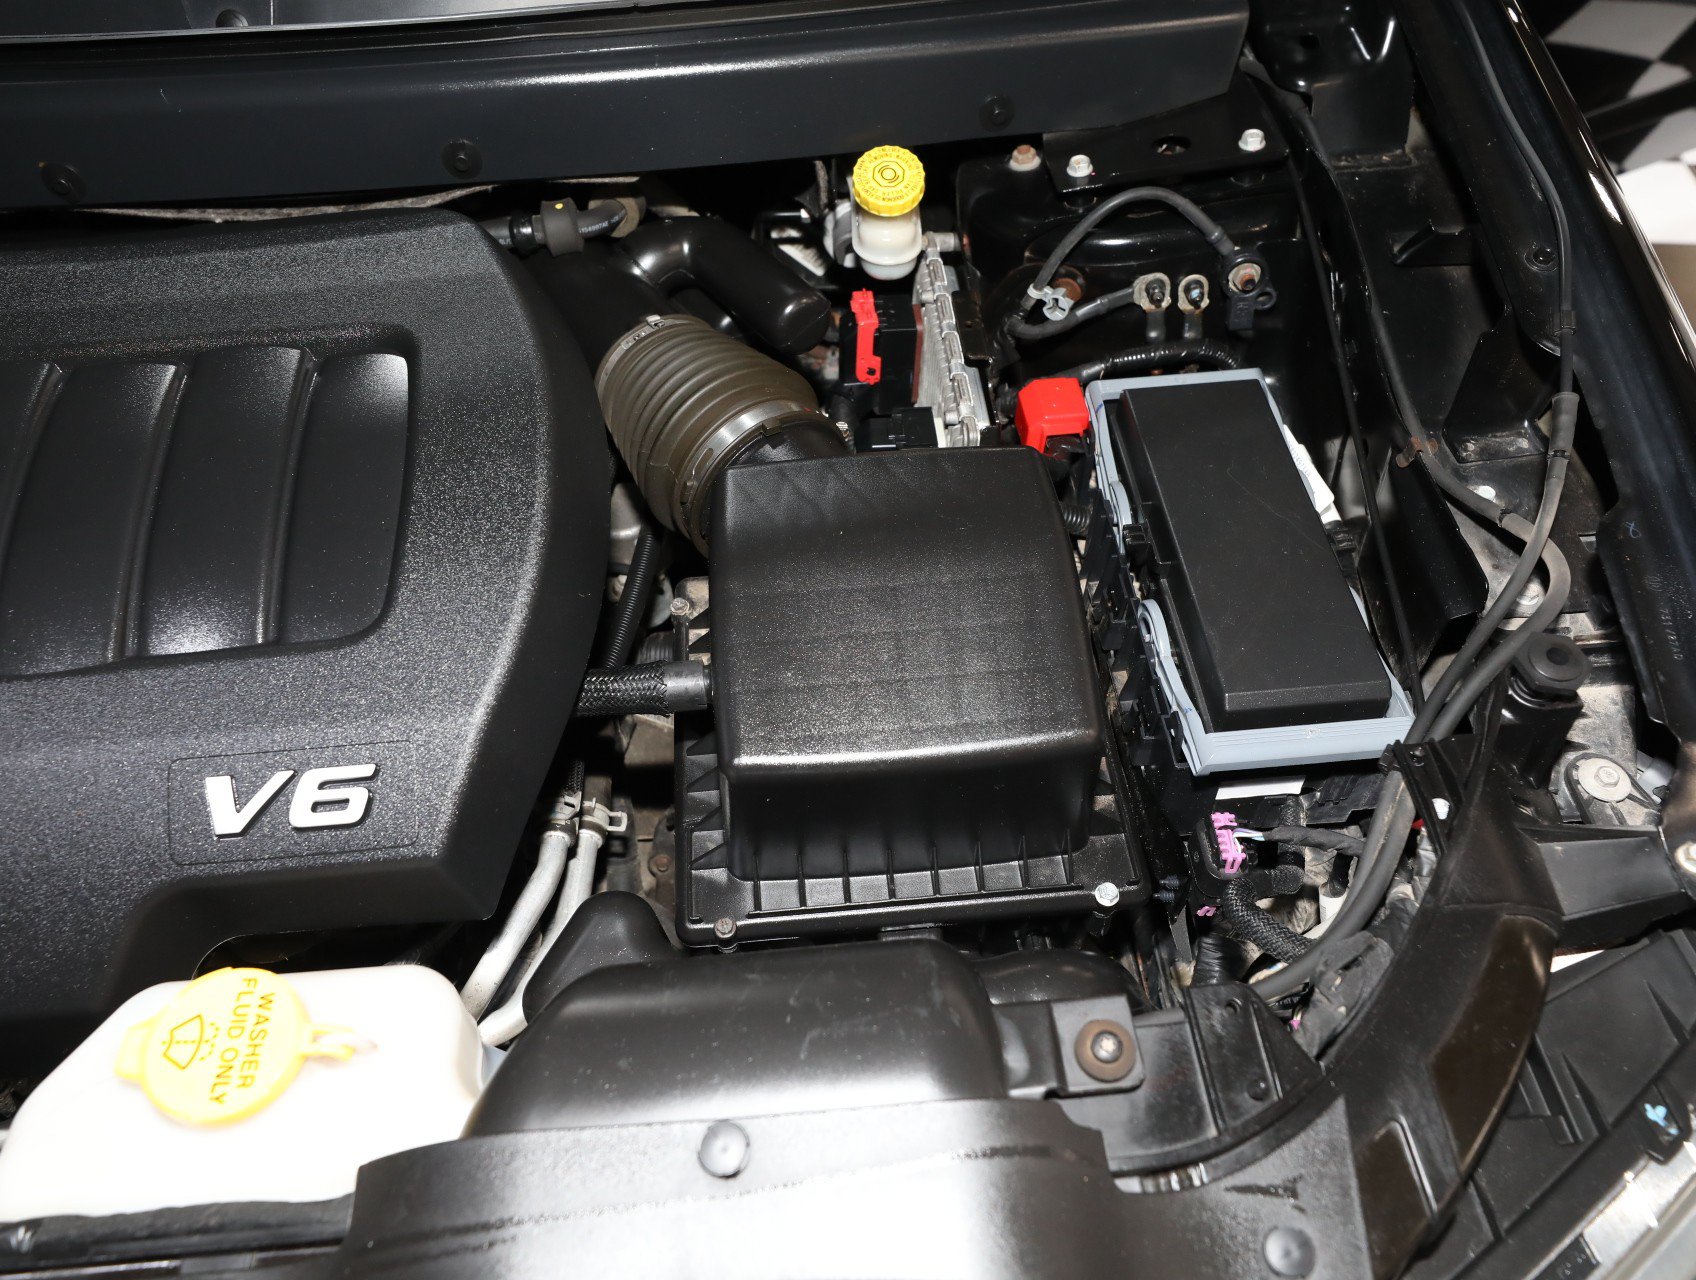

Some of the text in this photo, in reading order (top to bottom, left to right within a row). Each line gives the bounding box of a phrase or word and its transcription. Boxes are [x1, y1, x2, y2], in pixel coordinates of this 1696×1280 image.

[205, 763, 377, 837] V6
[209, 977, 258, 1105] FLUID ONLY
[236, 992, 276, 1089] WASHER
